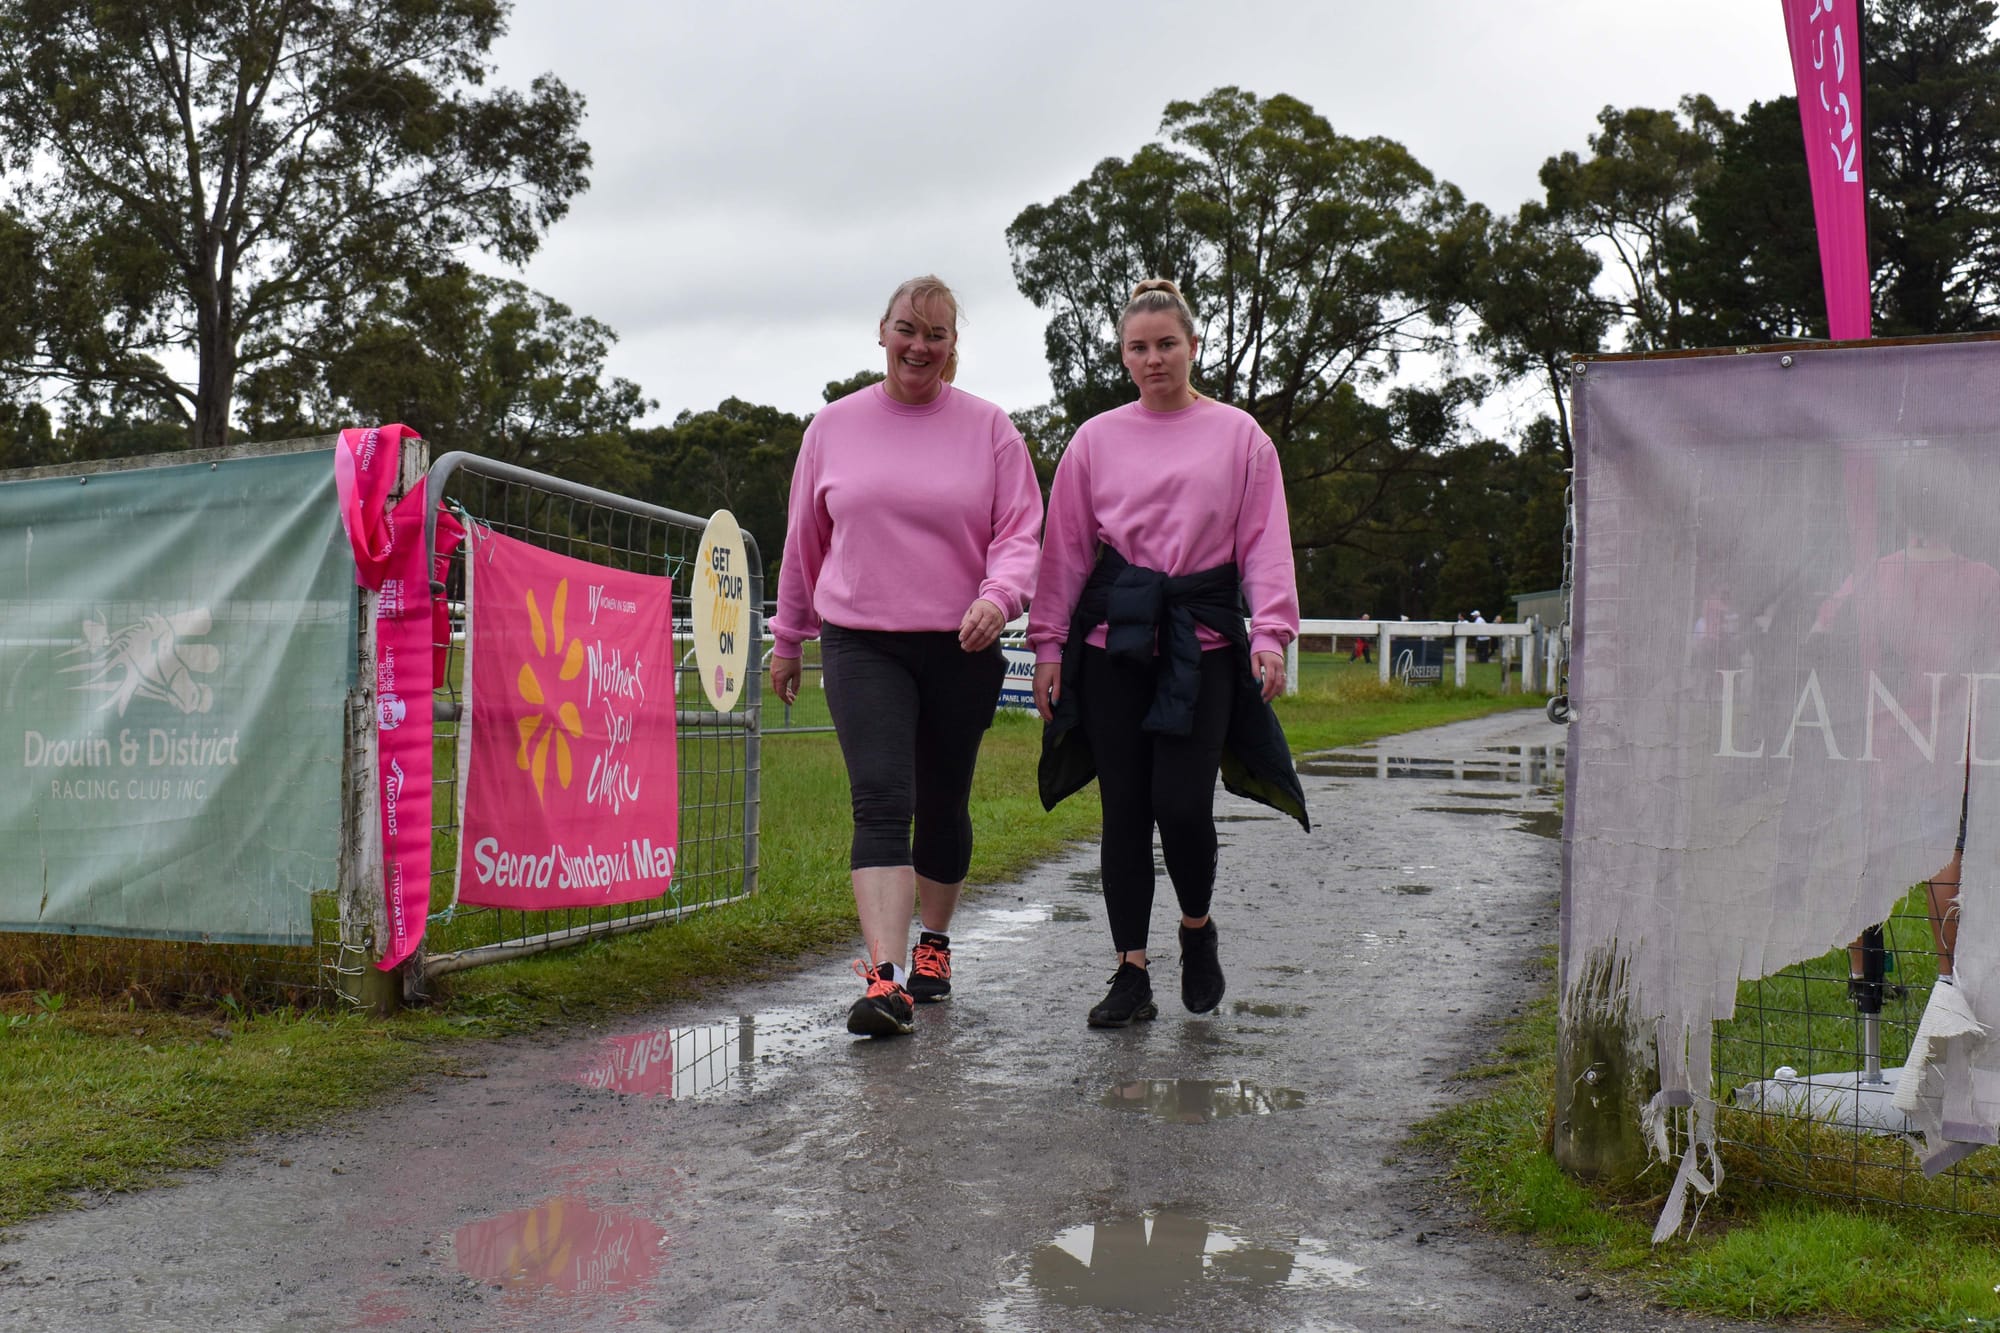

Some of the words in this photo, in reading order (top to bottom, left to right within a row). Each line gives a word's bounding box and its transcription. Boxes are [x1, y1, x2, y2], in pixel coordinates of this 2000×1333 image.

[712, 546, 731, 572] GET
[717, 573, 743, 600] YOUR
[719, 631, 734, 655] ON
[378, 662, 387, 692] SUPER
[385, 645, 394, 691] PROPERTY
[587, 639, 645, 709] Mother's
[1002, 694, 1020, 703] PANEL
[602, 697, 633, 758] Day
[23, 730, 112, 767] Drouin
[118, 728, 140, 767] &
[148, 728, 239, 767] District
[51, 779, 120, 800] RACING
[126, 779, 171, 800] CLUB
[386, 775, 398, 836] saucony
